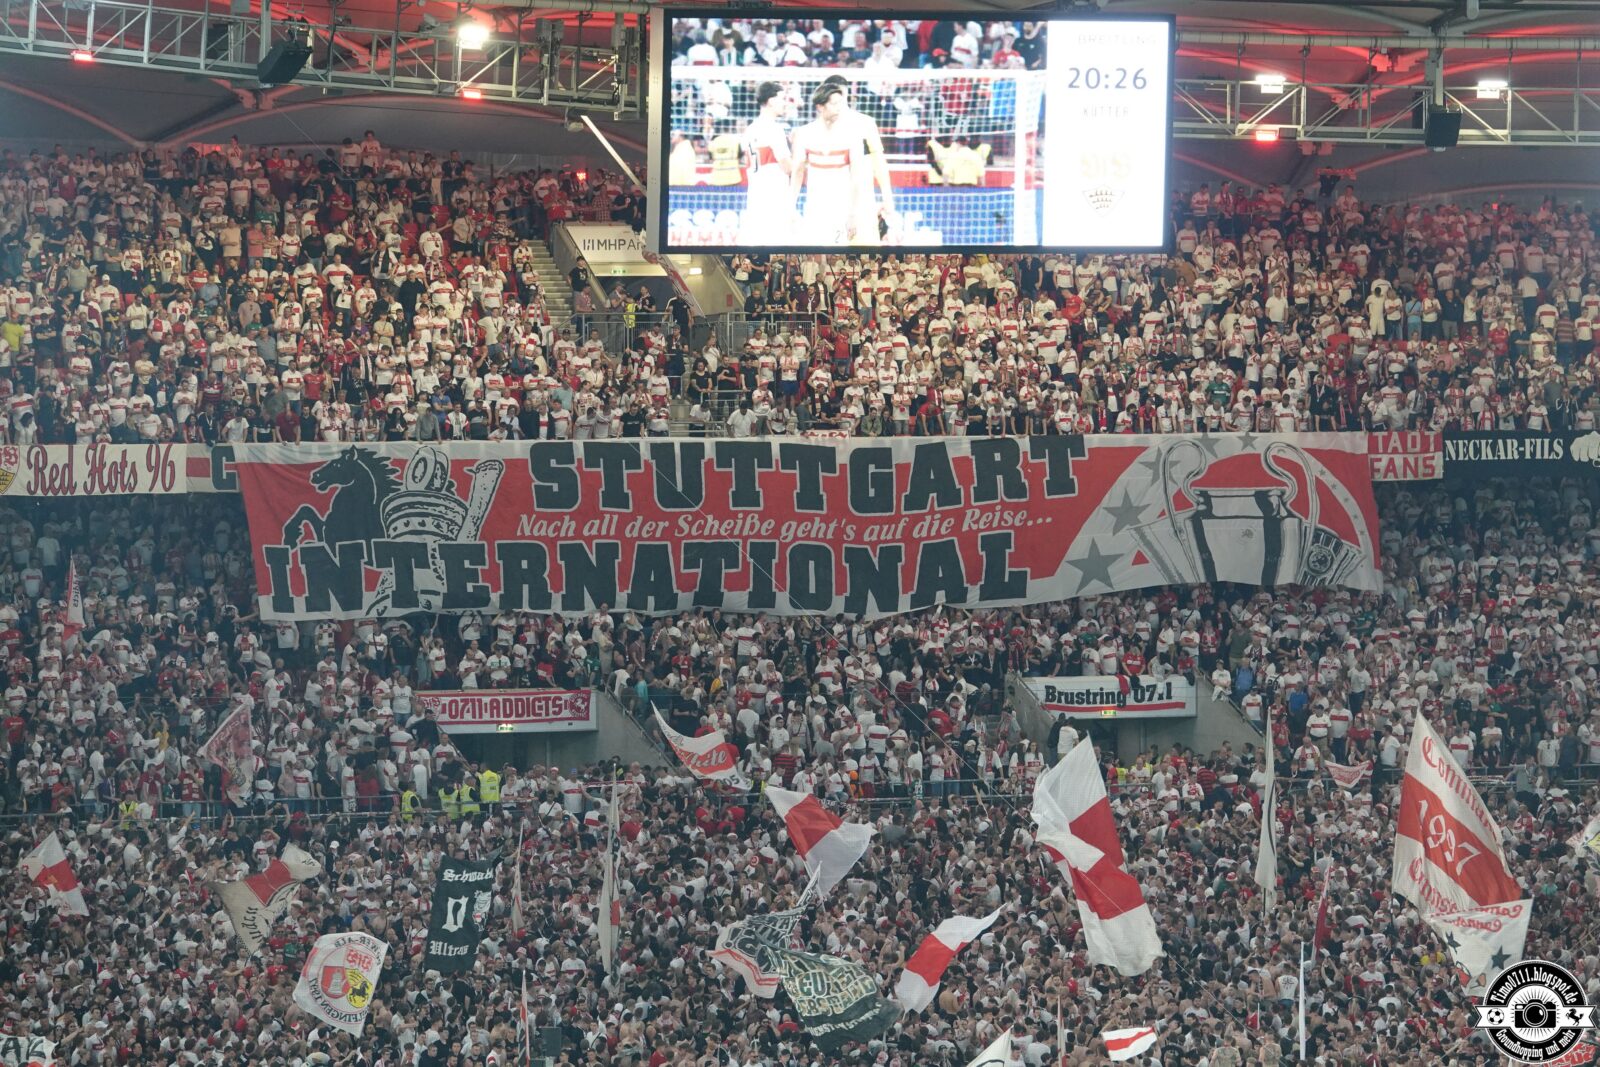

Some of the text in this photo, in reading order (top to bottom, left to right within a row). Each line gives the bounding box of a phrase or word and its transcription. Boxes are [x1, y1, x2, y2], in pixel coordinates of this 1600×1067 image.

[1068, 67, 1147, 90] 20:26
[597, 239, 626, 251] MHP
[1445, 438, 1564, 462] NECKAR-FILS
[27, 443, 176, 496] Red Hots 96
[530, 435, 1087, 516] STUTTGART
[1370, 455, 1435, 479] FANS
[517, 514, 575, 538] Nach
[583, 513, 617, 538] all
[624, 513, 669, 539] der
[674, 513, 776, 538] Scheiße
[780, 516, 856, 543] geht's
[863, 516, 906, 543] auf
[913, 513, 955, 540] die
[262, 530, 1029, 614] INTERNATIONAL
[448, 697, 483, 720] 0711
[489, 696, 563, 719] ADDICTS
[1044, 685, 1128, 709] Brustring
[1418, 799, 1482, 876] 1997
[429, 940, 470, 957] Ultras
